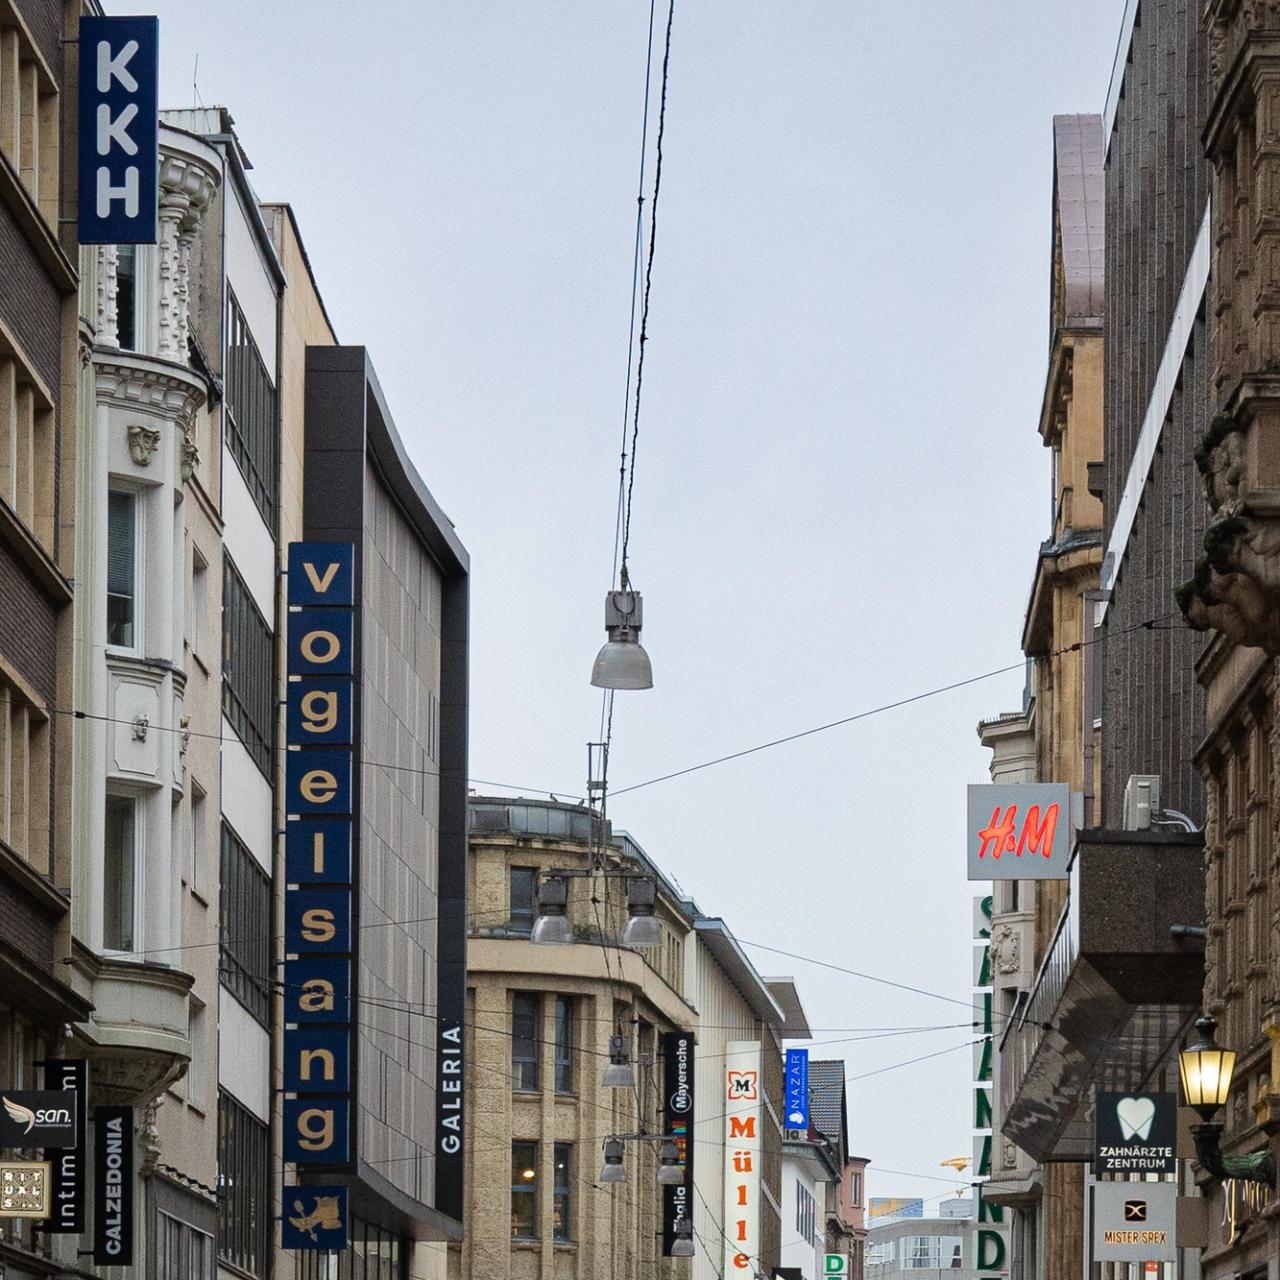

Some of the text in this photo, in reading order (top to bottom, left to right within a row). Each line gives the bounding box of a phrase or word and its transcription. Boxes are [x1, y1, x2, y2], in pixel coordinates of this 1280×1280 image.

[96, 39, 139, 218] KKH
[298, 562, 339, 1152] vogelsang
[978, 802, 1059, 860] H&M
[441, 1026, 460, 1155] GALERIA
[676, 1039, 689, 1108] Mayersche
[791, 1055, 800, 1109] NAZAR
[35, 1108, 71, 1123] san.
[1100, 1144, 1172, 1157] ZAHNÄRZTE
[1106, 1158, 1166, 1169] ZENTRUM
[106, 1117, 123, 1255] CALZEDONIA
[1104, 1231, 1167, 1244] MISTER SPEX
